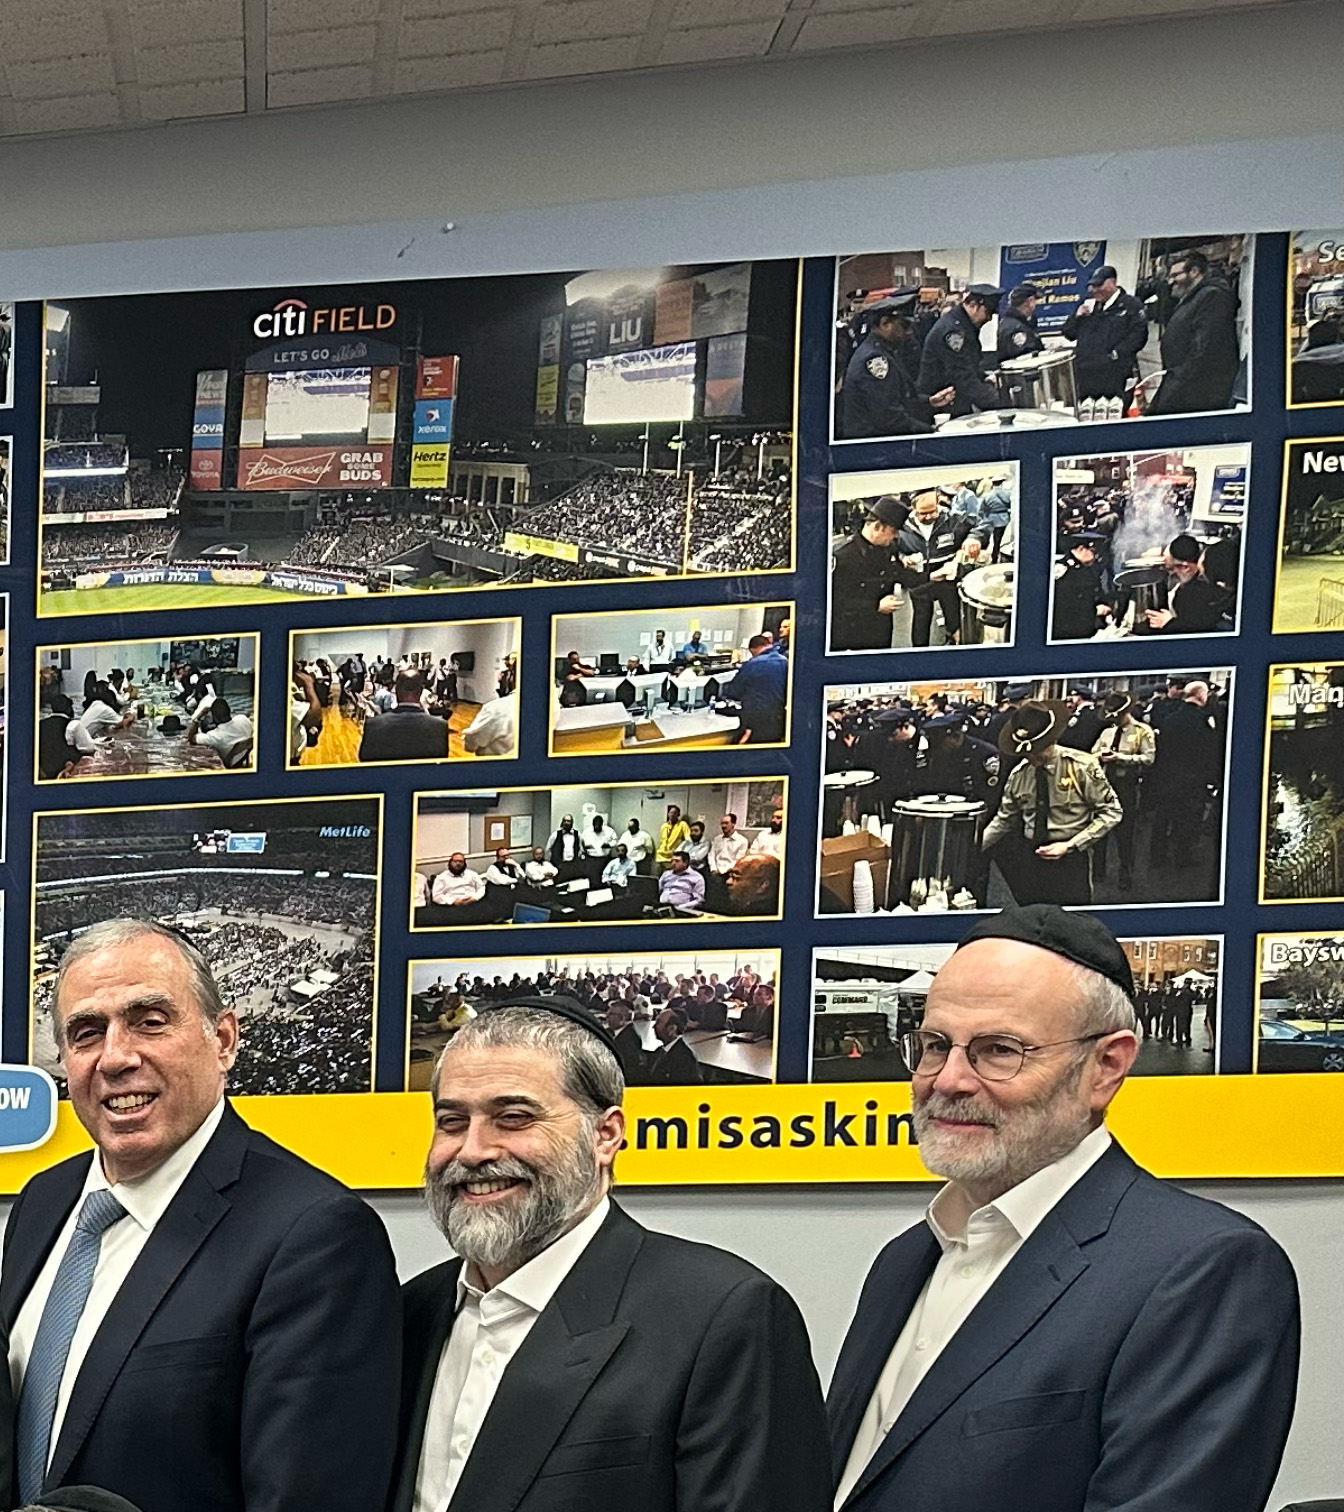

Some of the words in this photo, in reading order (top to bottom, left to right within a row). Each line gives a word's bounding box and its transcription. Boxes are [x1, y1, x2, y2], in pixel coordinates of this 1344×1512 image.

[313, 305, 396, 333] FIELD
[609, 317, 642, 345] LIU
[311, 349, 330, 361] GO
[192, 424, 223, 434] GOYA
[417, 425, 447, 434] xerox
[340, 452, 384, 463] GRAB
[413, 451, 447, 462] Hertz
[339, 470, 382, 482] BUDS
[318, 825, 372, 838] MetLife
